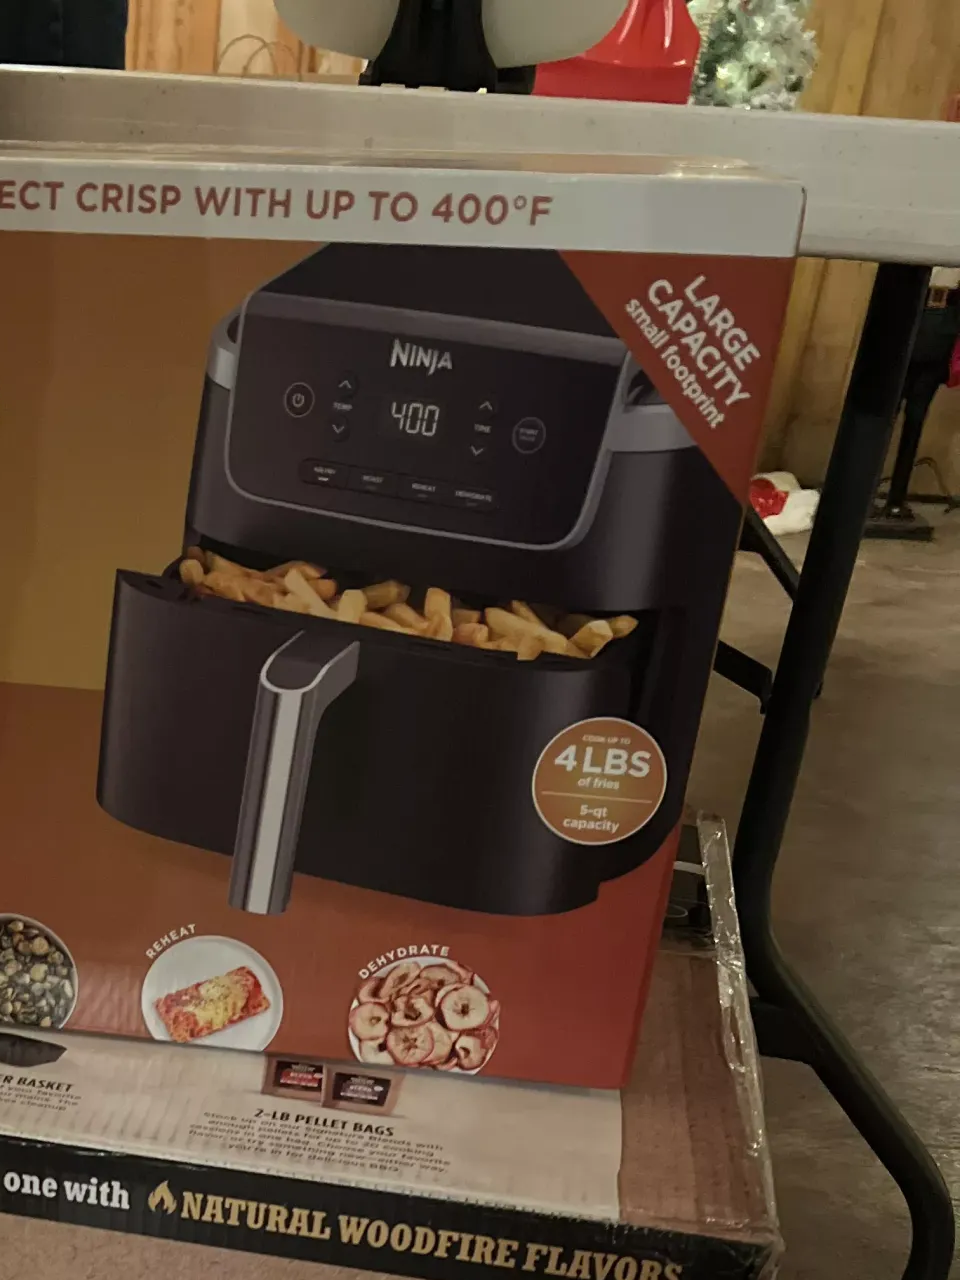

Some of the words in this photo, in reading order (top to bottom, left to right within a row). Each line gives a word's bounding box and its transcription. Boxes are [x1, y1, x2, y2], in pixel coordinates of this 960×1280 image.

[76, 182, 181, 214] CRISP
[195, 186, 292, 219] WITH
[306, 189, 355, 220] UP
[369, 191, 419, 222] TO
[431, 192, 554, 226] 400°F
[684, 274, 761, 371] LARGE
[390, 338, 453, 376] NINJA
[647, 279, 751, 407] CAPACITY
[624, 298, 670, 350] small
[660, 343, 725, 430] footprint
[391, 401, 440, 437] 400
[554, 744, 577, 772] 4
[582, 746, 652, 778] LBS
[578, 778, 591, 787] of
[593, 778, 620, 790] fries
[562, 817, 620, 834] capacity
[580, 805, 608, 818] 5-qt
[145, 923, 197, 959] REHEAT
[359, 944, 451, 980] DEHYDRATE
[17, 1078, 74, 1092] BASKET
[295, 1115, 348, 1130] PELLET
[353, 1122, 394, 1136] BAGS
[3, 1172, 58, 1197] one
[63, 1177, 130, 1210] with
[180, 1191, 331, 1241] NATURAL
[337, 1215, 519, 1269] WOODFIRE
